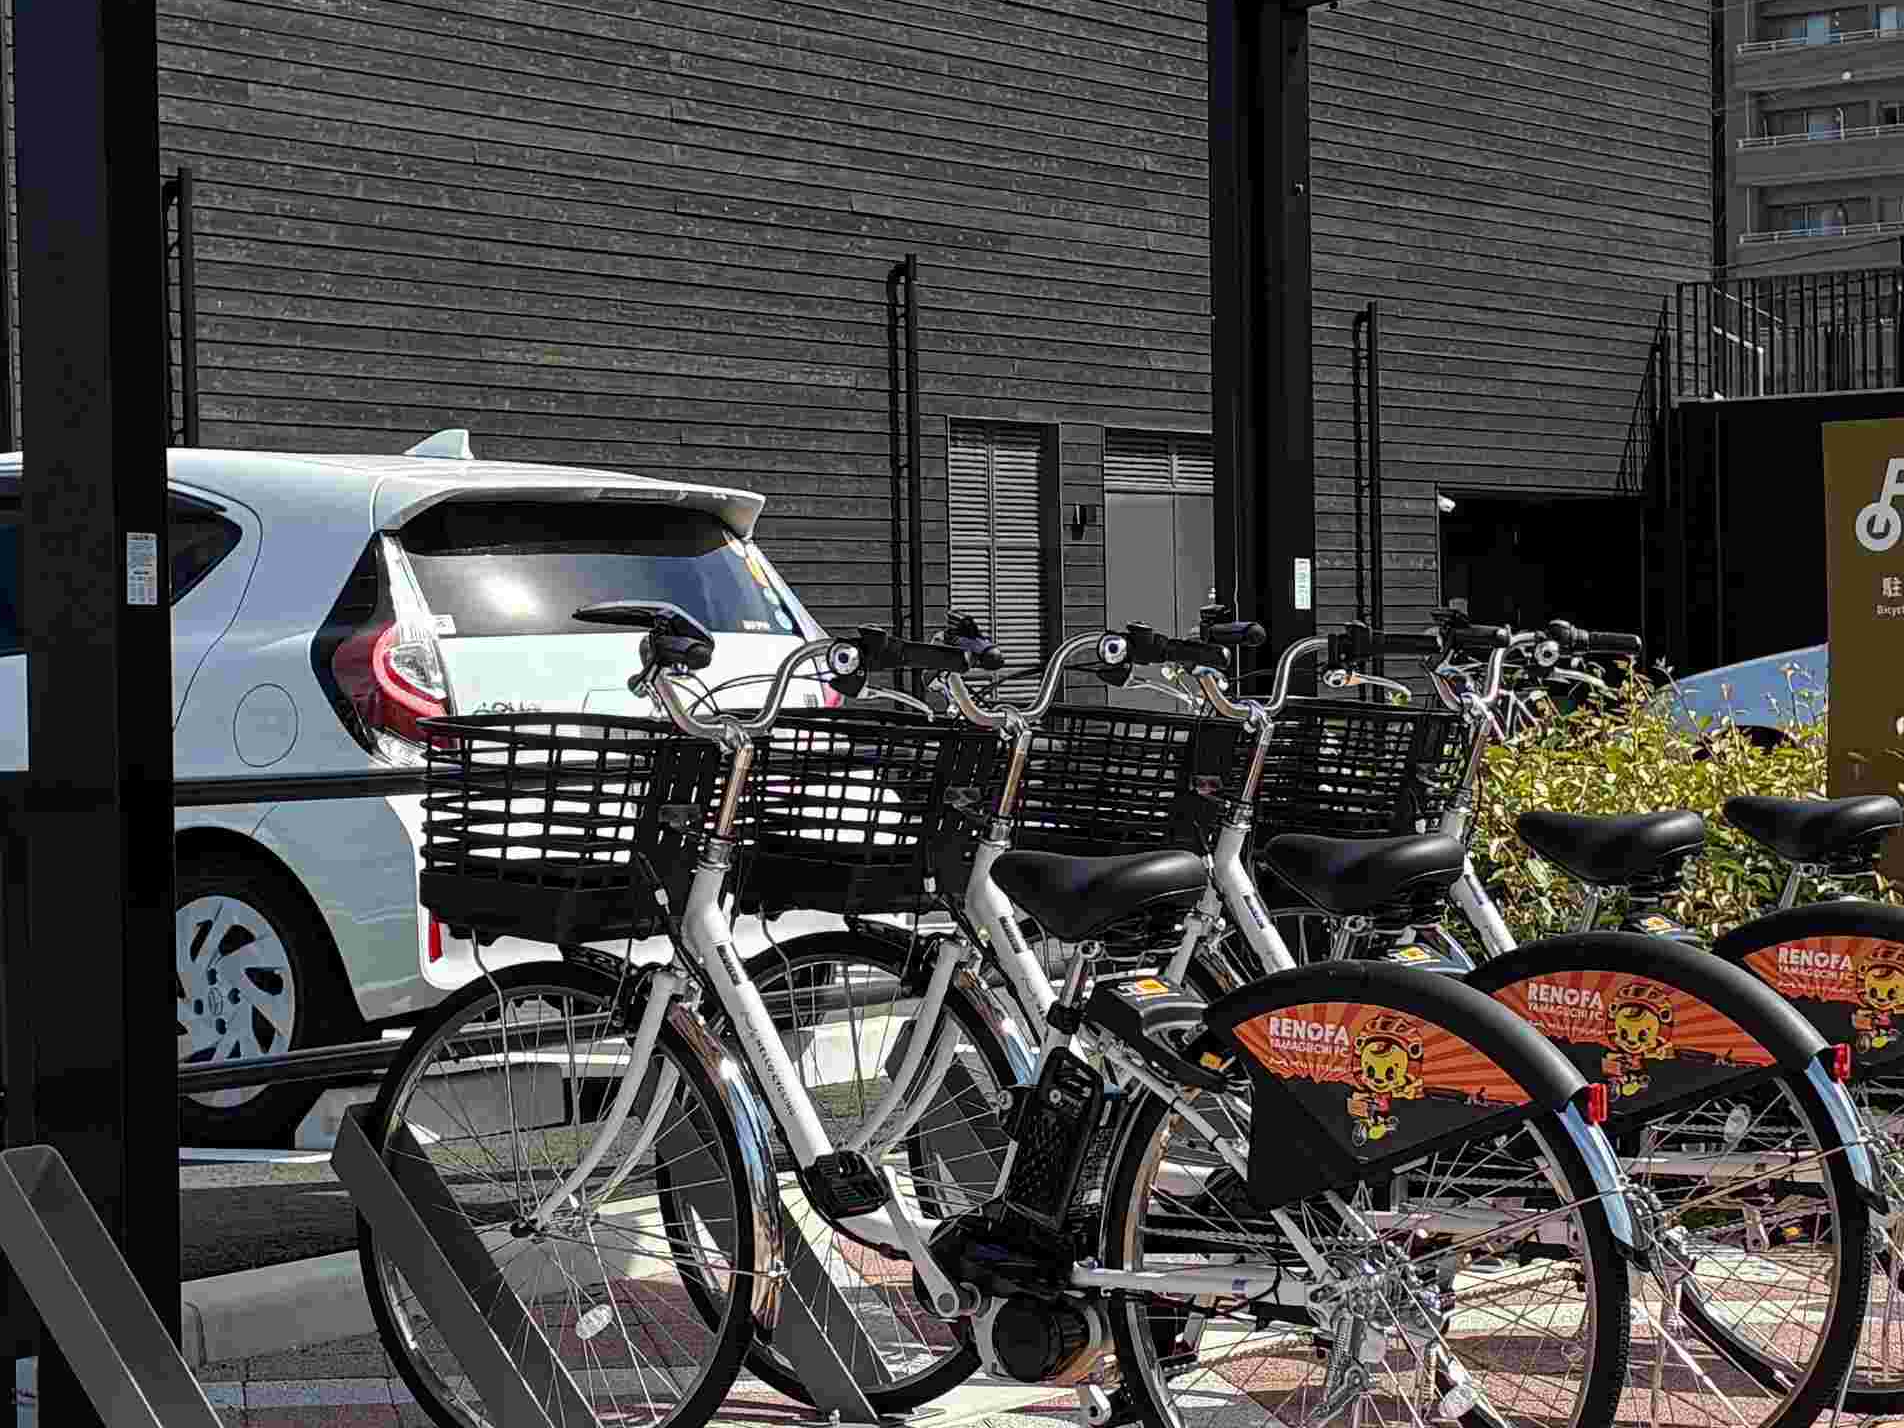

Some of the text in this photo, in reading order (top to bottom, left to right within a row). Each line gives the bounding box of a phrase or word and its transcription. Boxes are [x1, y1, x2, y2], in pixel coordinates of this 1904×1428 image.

[1777, 947, 1853, 972] RENOFA
[1527, 982, 1604, 1010] RENOFA
[1269, 1016, 1350, 1048] RENOFA
